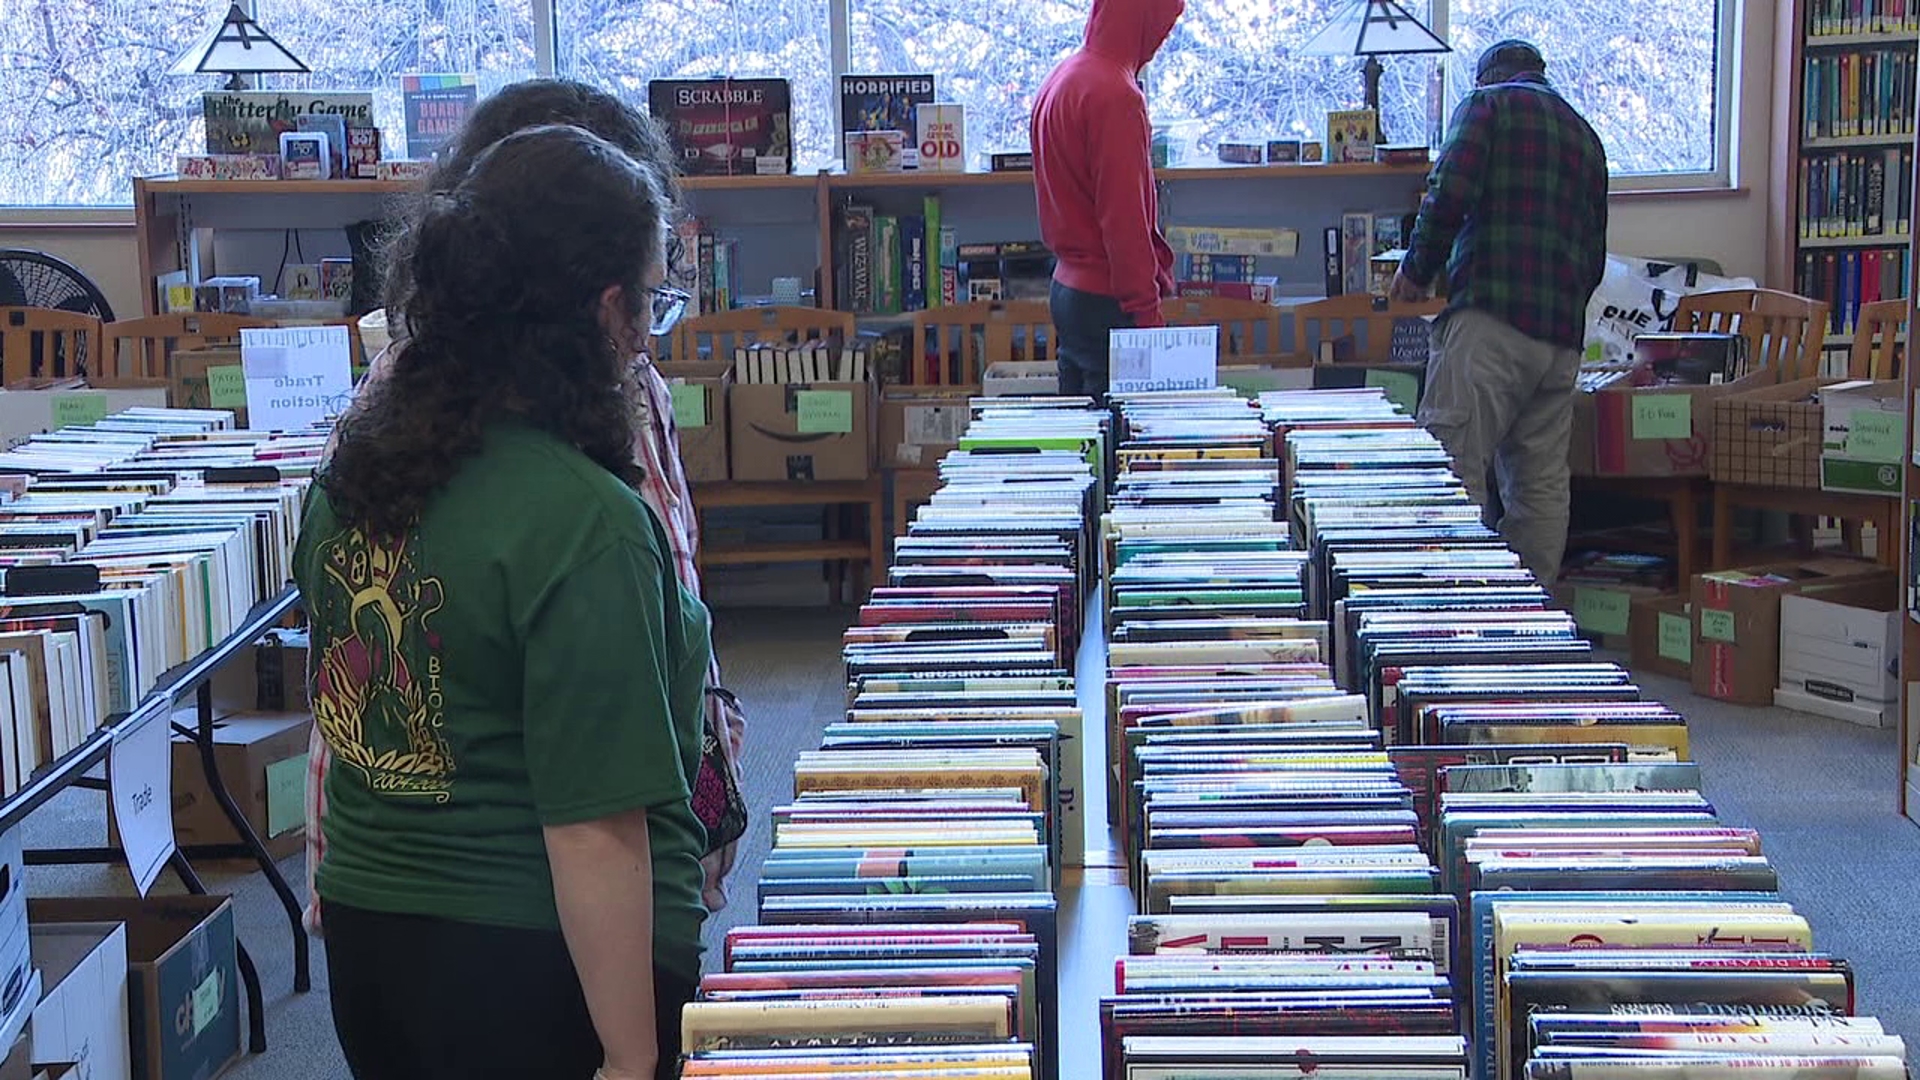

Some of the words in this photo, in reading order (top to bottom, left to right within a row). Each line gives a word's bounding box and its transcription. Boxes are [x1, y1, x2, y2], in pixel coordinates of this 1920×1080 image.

[843, 80, 932, 95] HORRIFIED
[677, 88, 763, 105] SCRABBLE
[308, 101, 369, 119] Game
[920, 142, 960, 159] OLD
